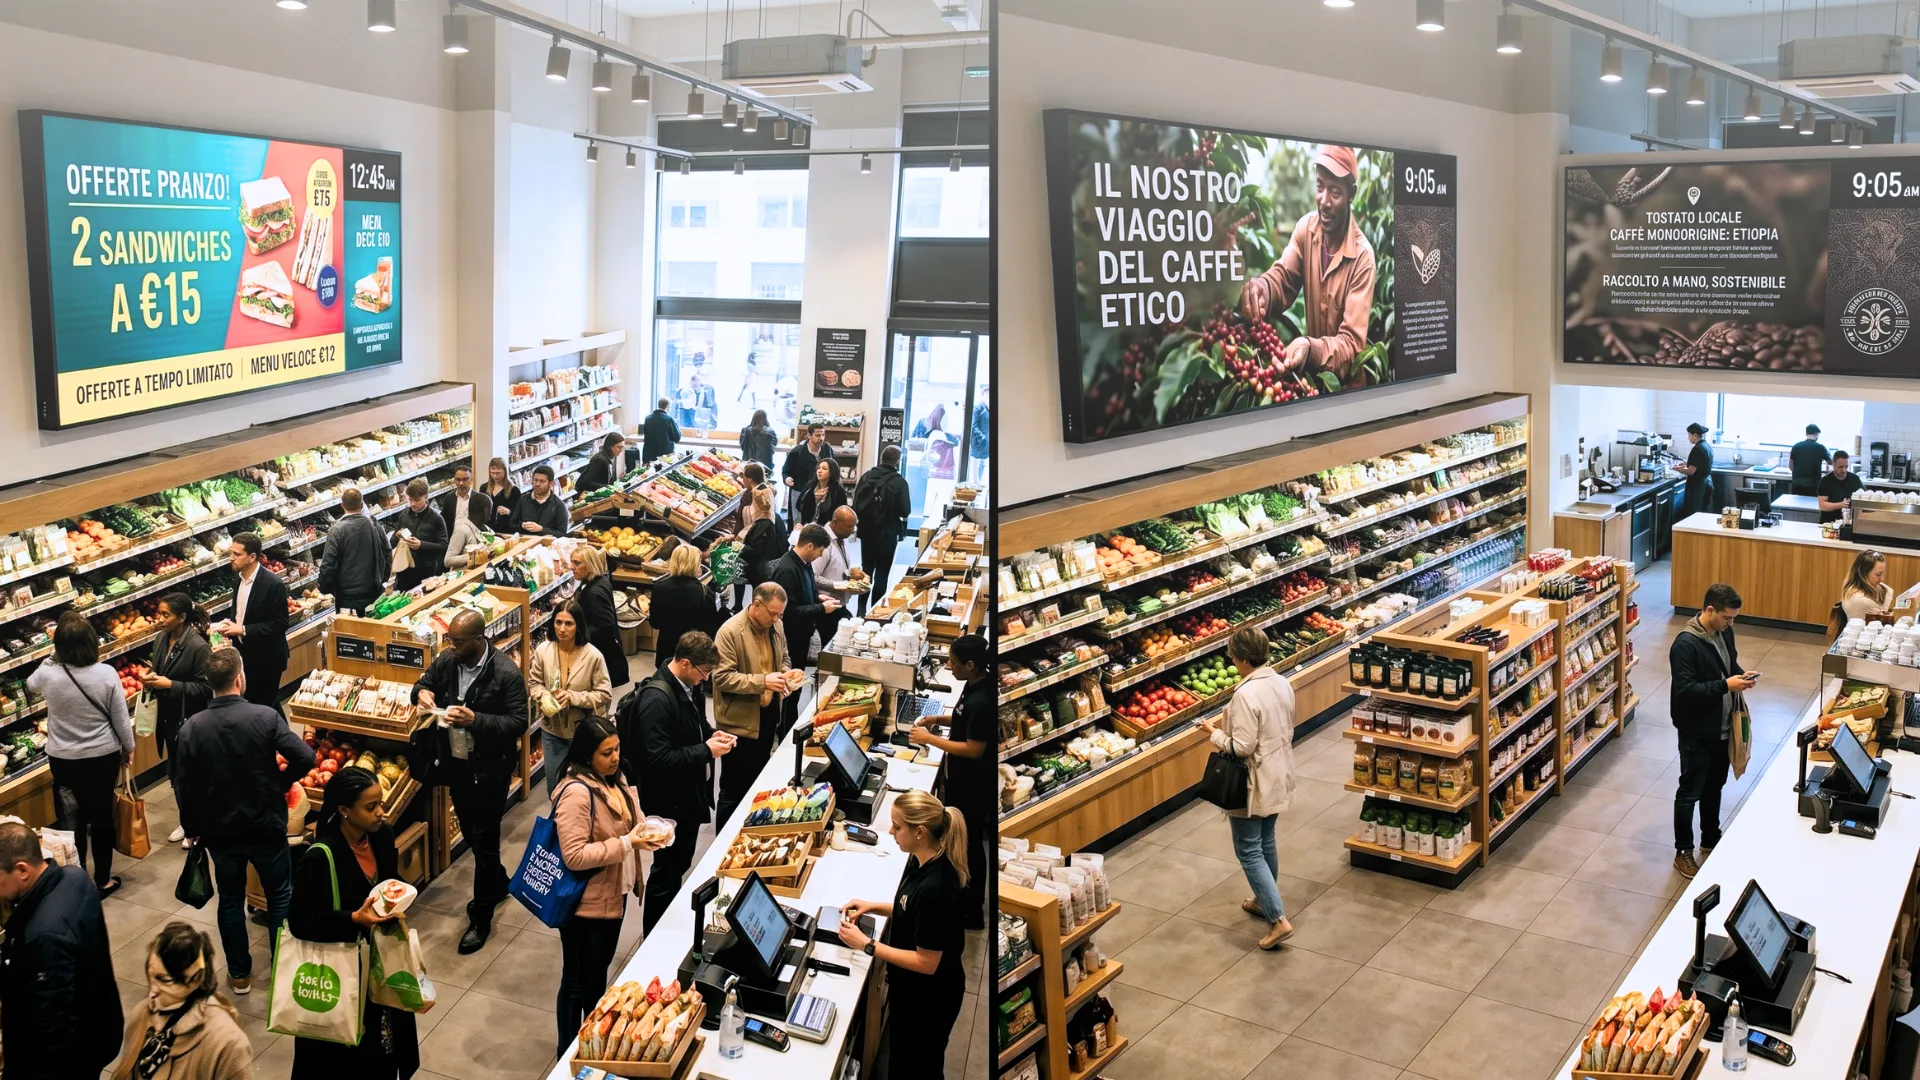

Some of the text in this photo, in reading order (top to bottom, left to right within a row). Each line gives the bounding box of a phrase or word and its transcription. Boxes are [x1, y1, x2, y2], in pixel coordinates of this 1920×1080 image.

[66, 164, 231, 201] OFFERTE PRANZO!
[350, 163, 386, 190] 12:45
[1094, 162, 1242, 204] IL NOSTRO
[1405, 166, 1436, 195] 9:05
[1852, 171, 1902, 198] 9:05
[1094, 206, 1213, 243] VIAGGIO
[1610, 225, 1779, 241] CAFFÈ MONOORIGINE: ETIOPIA
[1645, 211, 1743, 224] TOSTATO LOCALE
[70, 216, 232, 267] 2 SANDWICHES
[1098, 250, 1154, 285] DEL
[1602, 274, 1787, 290] RACCOLTO A MANO, SOSTENIBILE
[110, 270, 201, 333] A €15
[1100, 290, 1186, 328] ETICO
[250, 345, 336, 375] MENU VELOCE €12
[76, 362, 233, 405] OFFERTE A TEMPO LIMITATO
